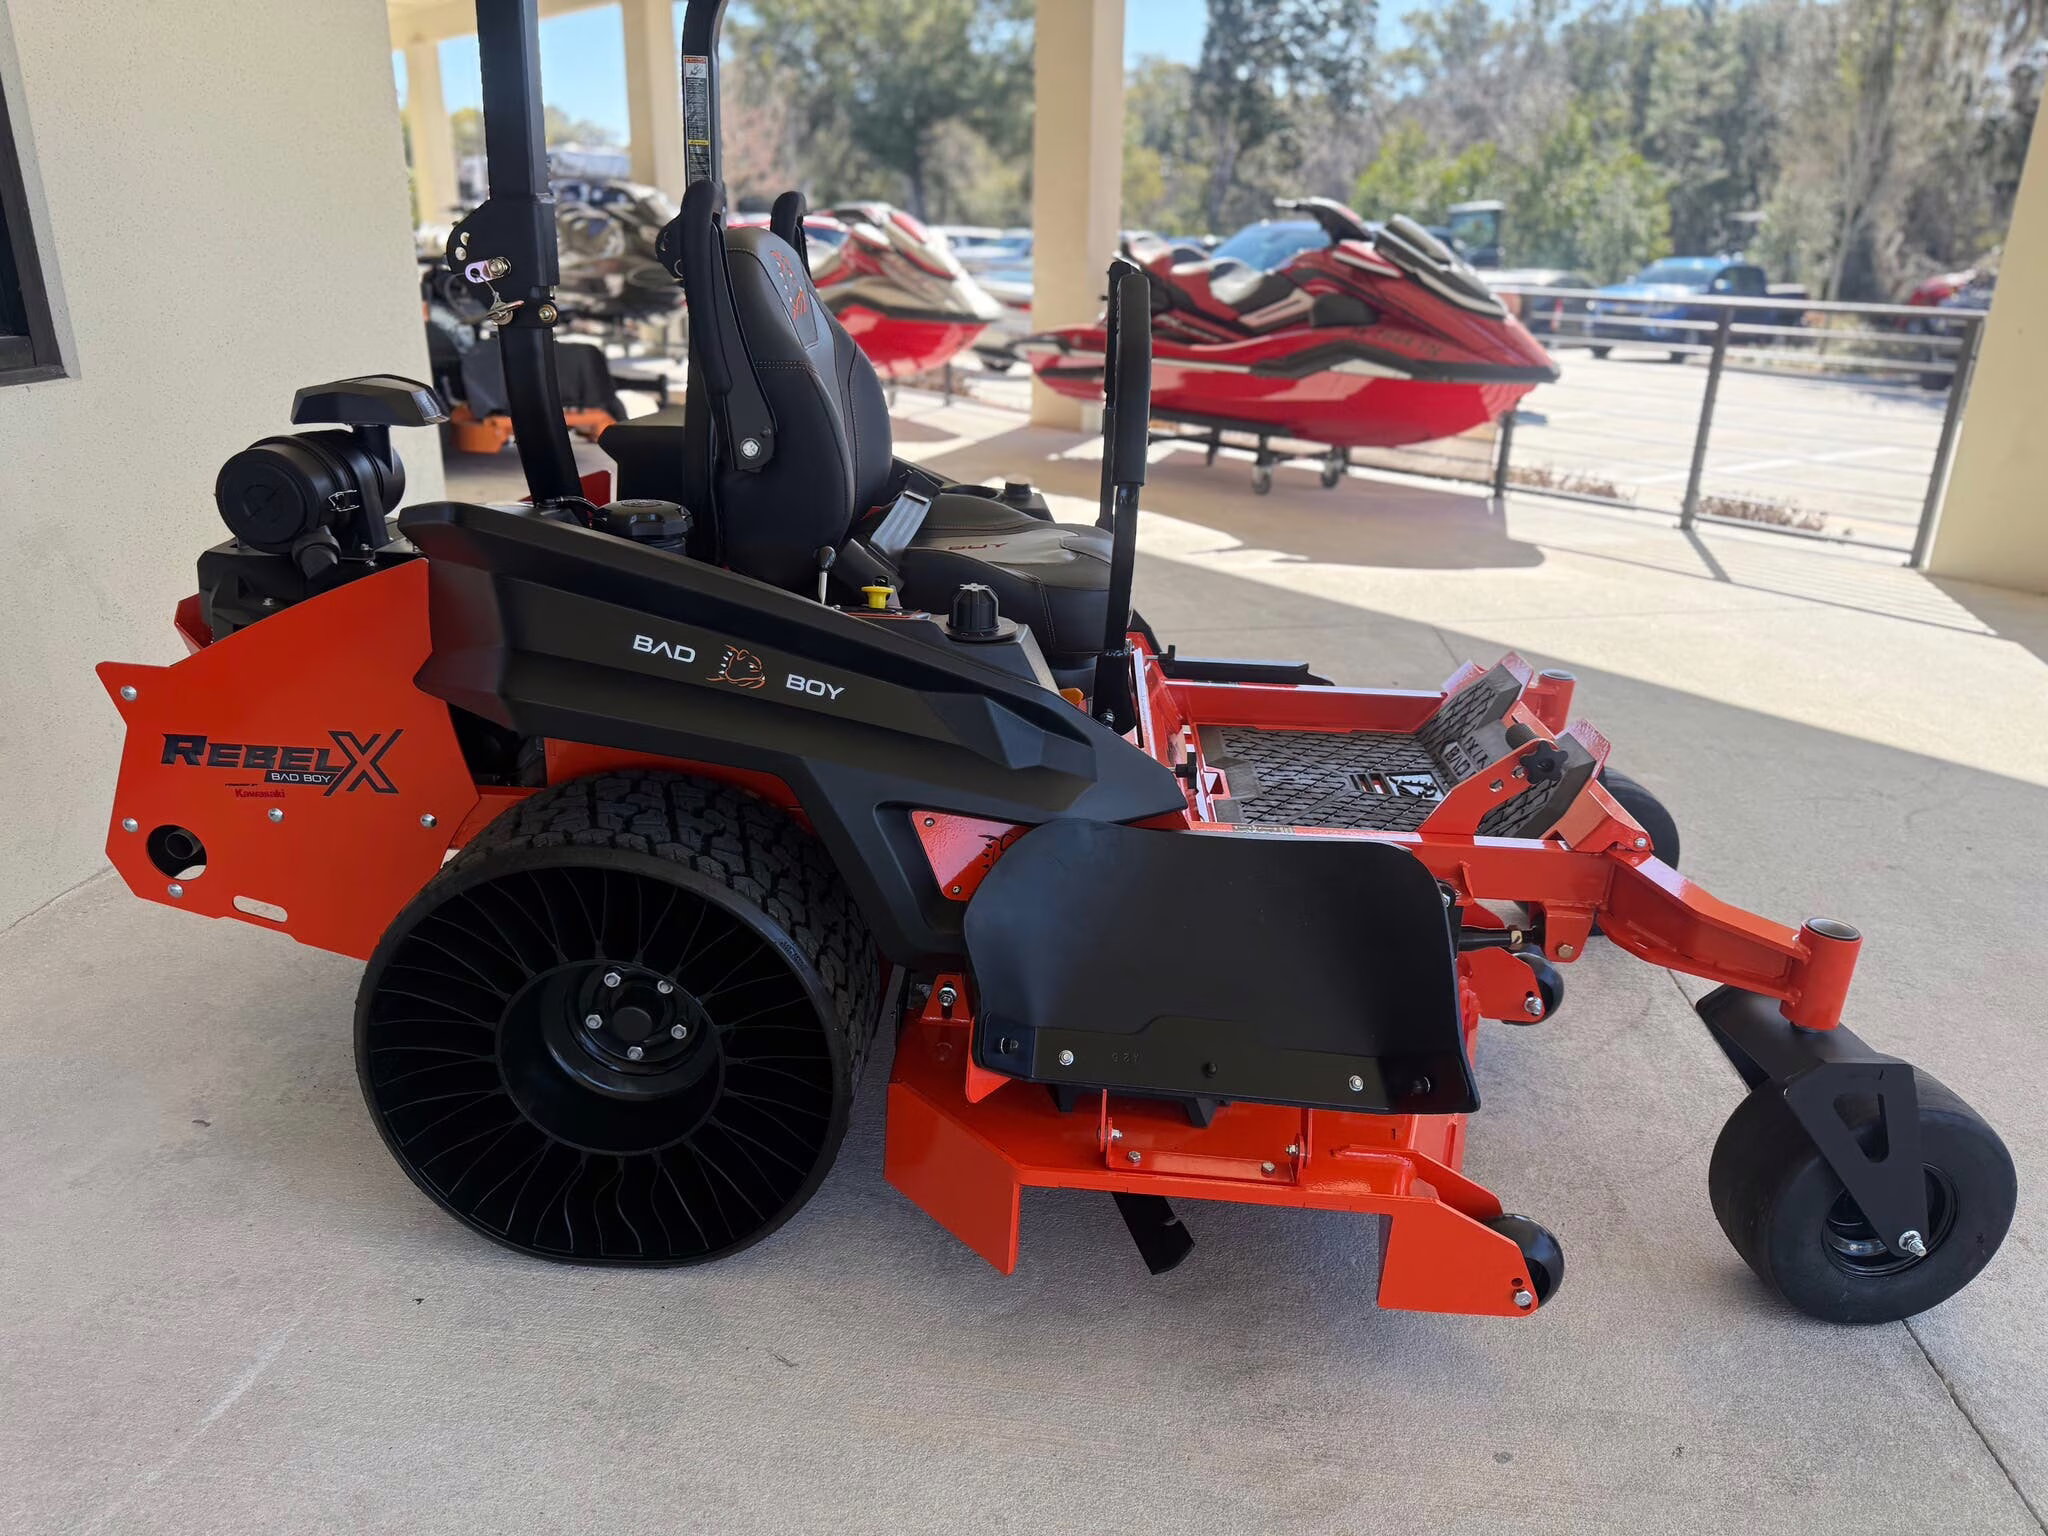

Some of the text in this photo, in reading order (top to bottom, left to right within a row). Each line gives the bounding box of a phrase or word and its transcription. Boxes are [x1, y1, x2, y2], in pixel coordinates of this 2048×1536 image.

[632, 634, 845, 700] BAD BOY
[271, 772, 331, 783] BAD BOY
[235, 788, 286, 798] Kawasaki
